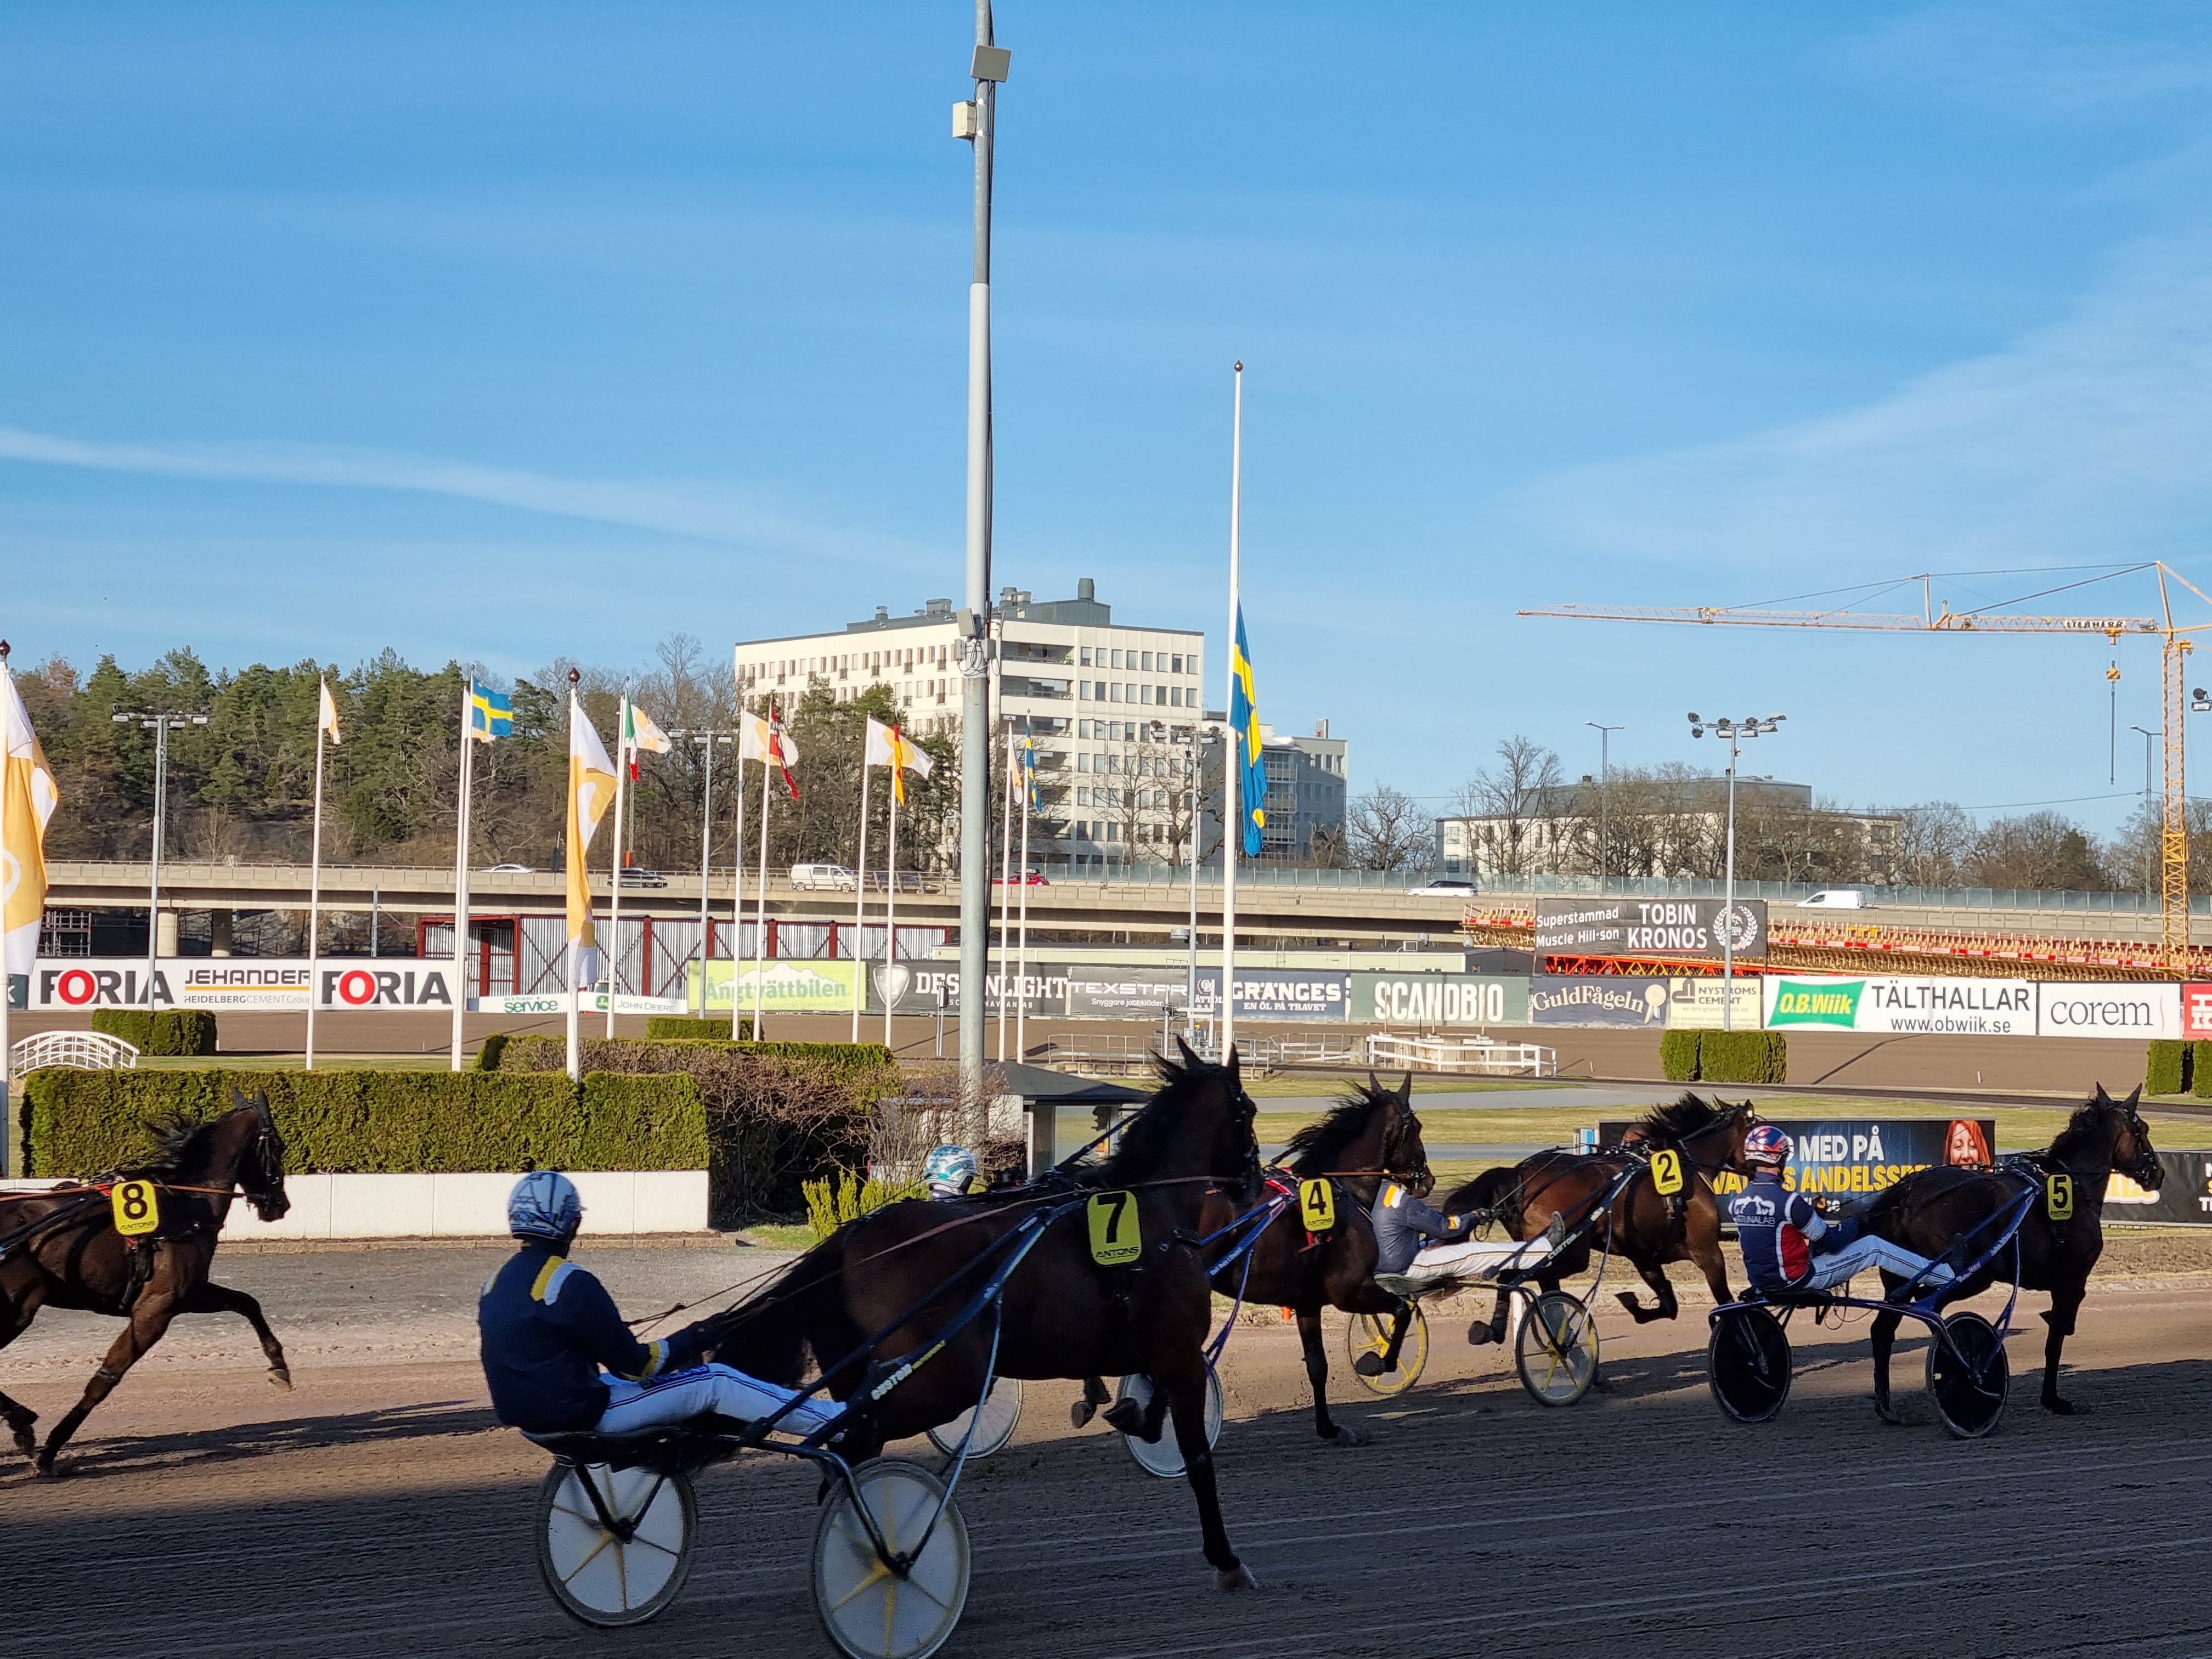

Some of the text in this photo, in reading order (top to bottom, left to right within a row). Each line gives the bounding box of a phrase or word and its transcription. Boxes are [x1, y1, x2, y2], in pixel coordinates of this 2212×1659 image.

[1536, 907, 1618, 929] Superstammad
[1639, 904, 1696, 926] TOBIN
[1536, 928, 1620, 949] Muscle Hill-son
[1628, 927, 1707, 949] KRONOS
[41, 969, 175, 1005] FORIA
[321, 969, 452, 1005] FORIA
[916, 972, 1069, 999] DESNLIGHT
[1070, 981, 1188, 996] TEXSTAR
[1233, 981, 1341, 1002] GRÄNGES
[1871, 980, 2030, 1011] TÄLTHALLAR
[287, 996, 309, 1004] Grou
[504, 997, 558, 1013] service
[617, 1000, 675, 1012] JOHN DEERE
[1091, 998, 1125, 1007] Snyggare
[1243, 1001, 1327, 1012] EN ÖL PÅ TRAVET
[1374, 980, 1504, 1023] SCANDBIO
[1532, 985, 1645, 1014] GuldFågeln
[1891, 1015, 2011, 1032] www.obwiik.se
[2050, 1001, 2153, 1026] corem
[1799, 1135, 1848, 1162] MED
[1852, 1125, 1885, 1161] PÅ
[1657, 1153, 1677, 1183] 2
[122, 1183, 147, 1220] 8
[1308, 1181, 1327, 1216] 4
[2052, 1176, 2068, 1209] 5
[1097, 1191, 1127, 1244] 7
